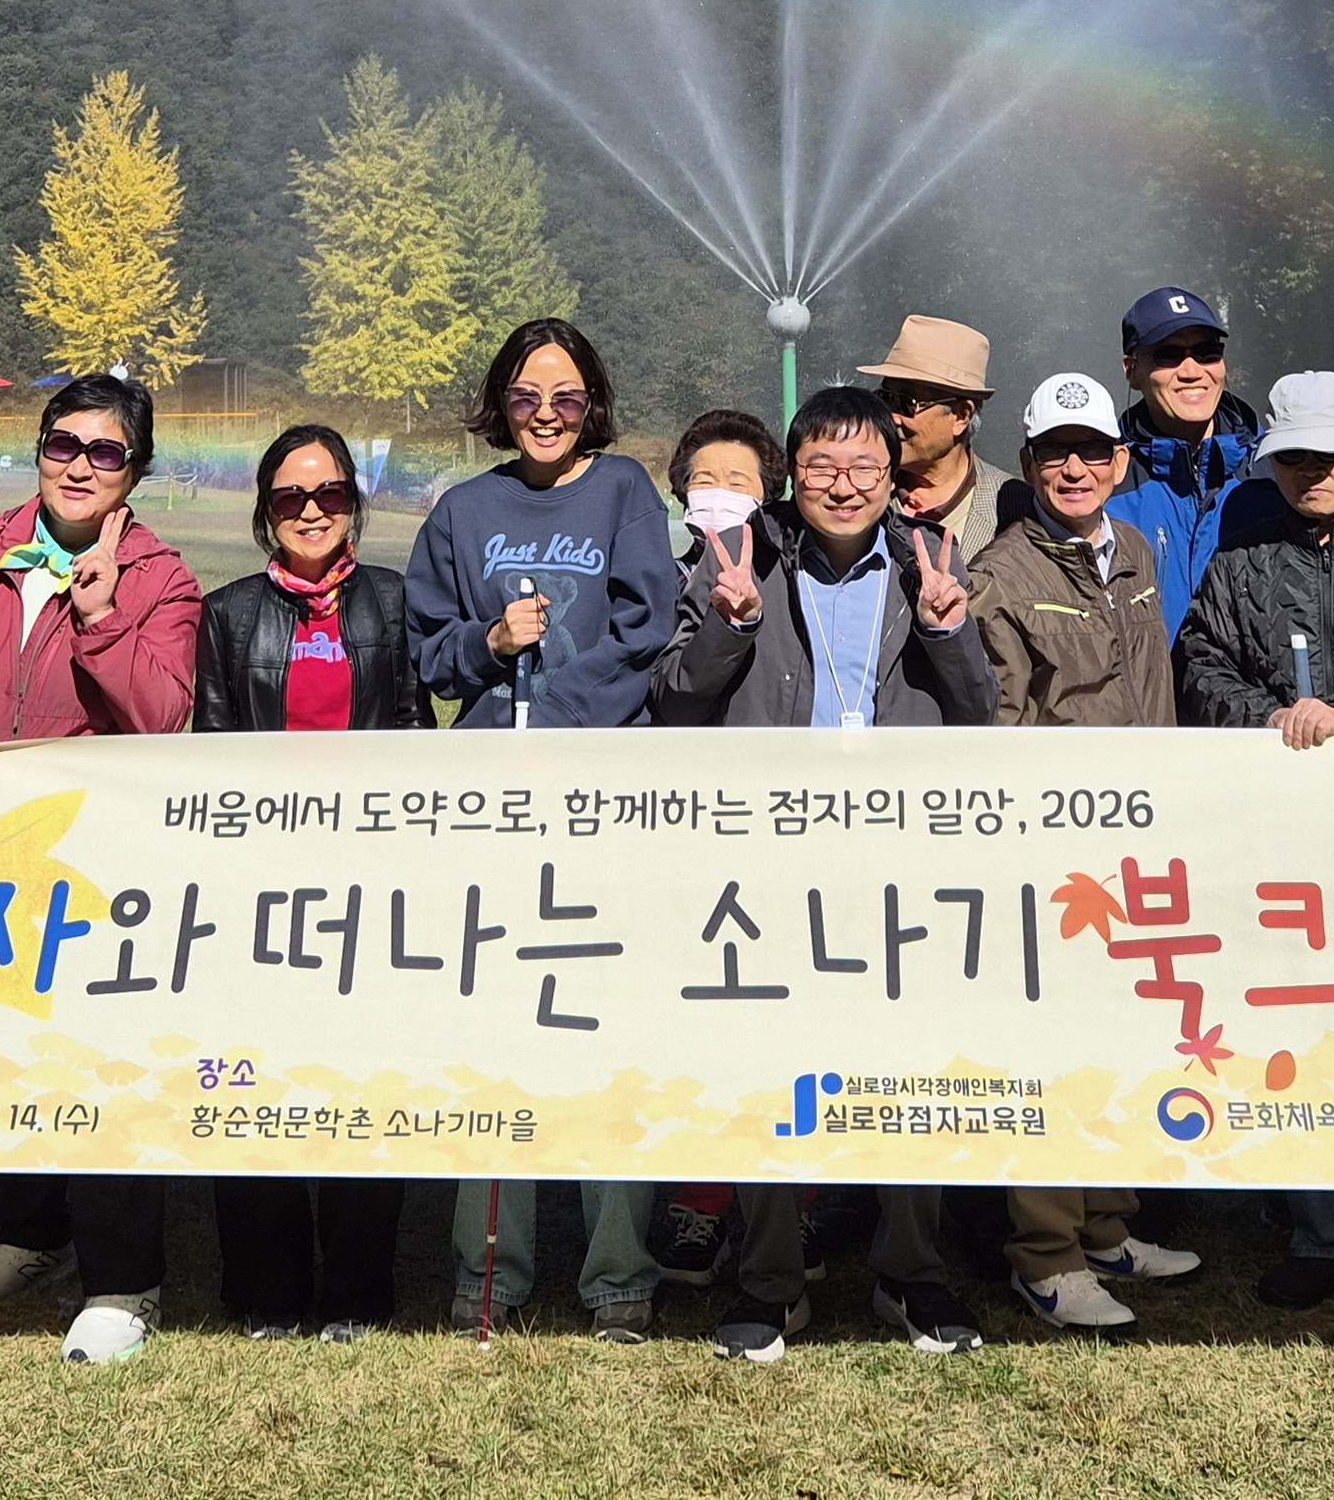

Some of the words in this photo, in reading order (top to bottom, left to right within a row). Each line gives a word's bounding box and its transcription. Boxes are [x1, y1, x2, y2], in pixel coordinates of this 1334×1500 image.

[1168, 295, 1190, 314] C
[483, 533, 538, 580] Just
[542, 533, 605, 573] Kids
[164, 790, 341, 838] 배움에서
[355, 789, 548, 837] 도약으로,
[564, 787, 753, 836] 함께하는
[768, 788, 905, 836] 점자의
[922, 787, 1028, 836] 일상,
[1041, 789, 1155, 829] 2026
[252, 862, 624, 1032] 떠나는
[679, 880, 1041, 1003] 소나기
[196, 1057, 257, 1090] 장소
[845, 1075, 1043, 1098] 실로암시각장애인복지회
[9, 1103, 44, 1133] 14.
[53, 1103, 100, 1136] (수)
[190, 1105, 375, 1140] 황순원문학촌
[382, 1109, 539, 1143] 소나기마을
[822, 1103, 1047, 1137] 실로암점자교육원
